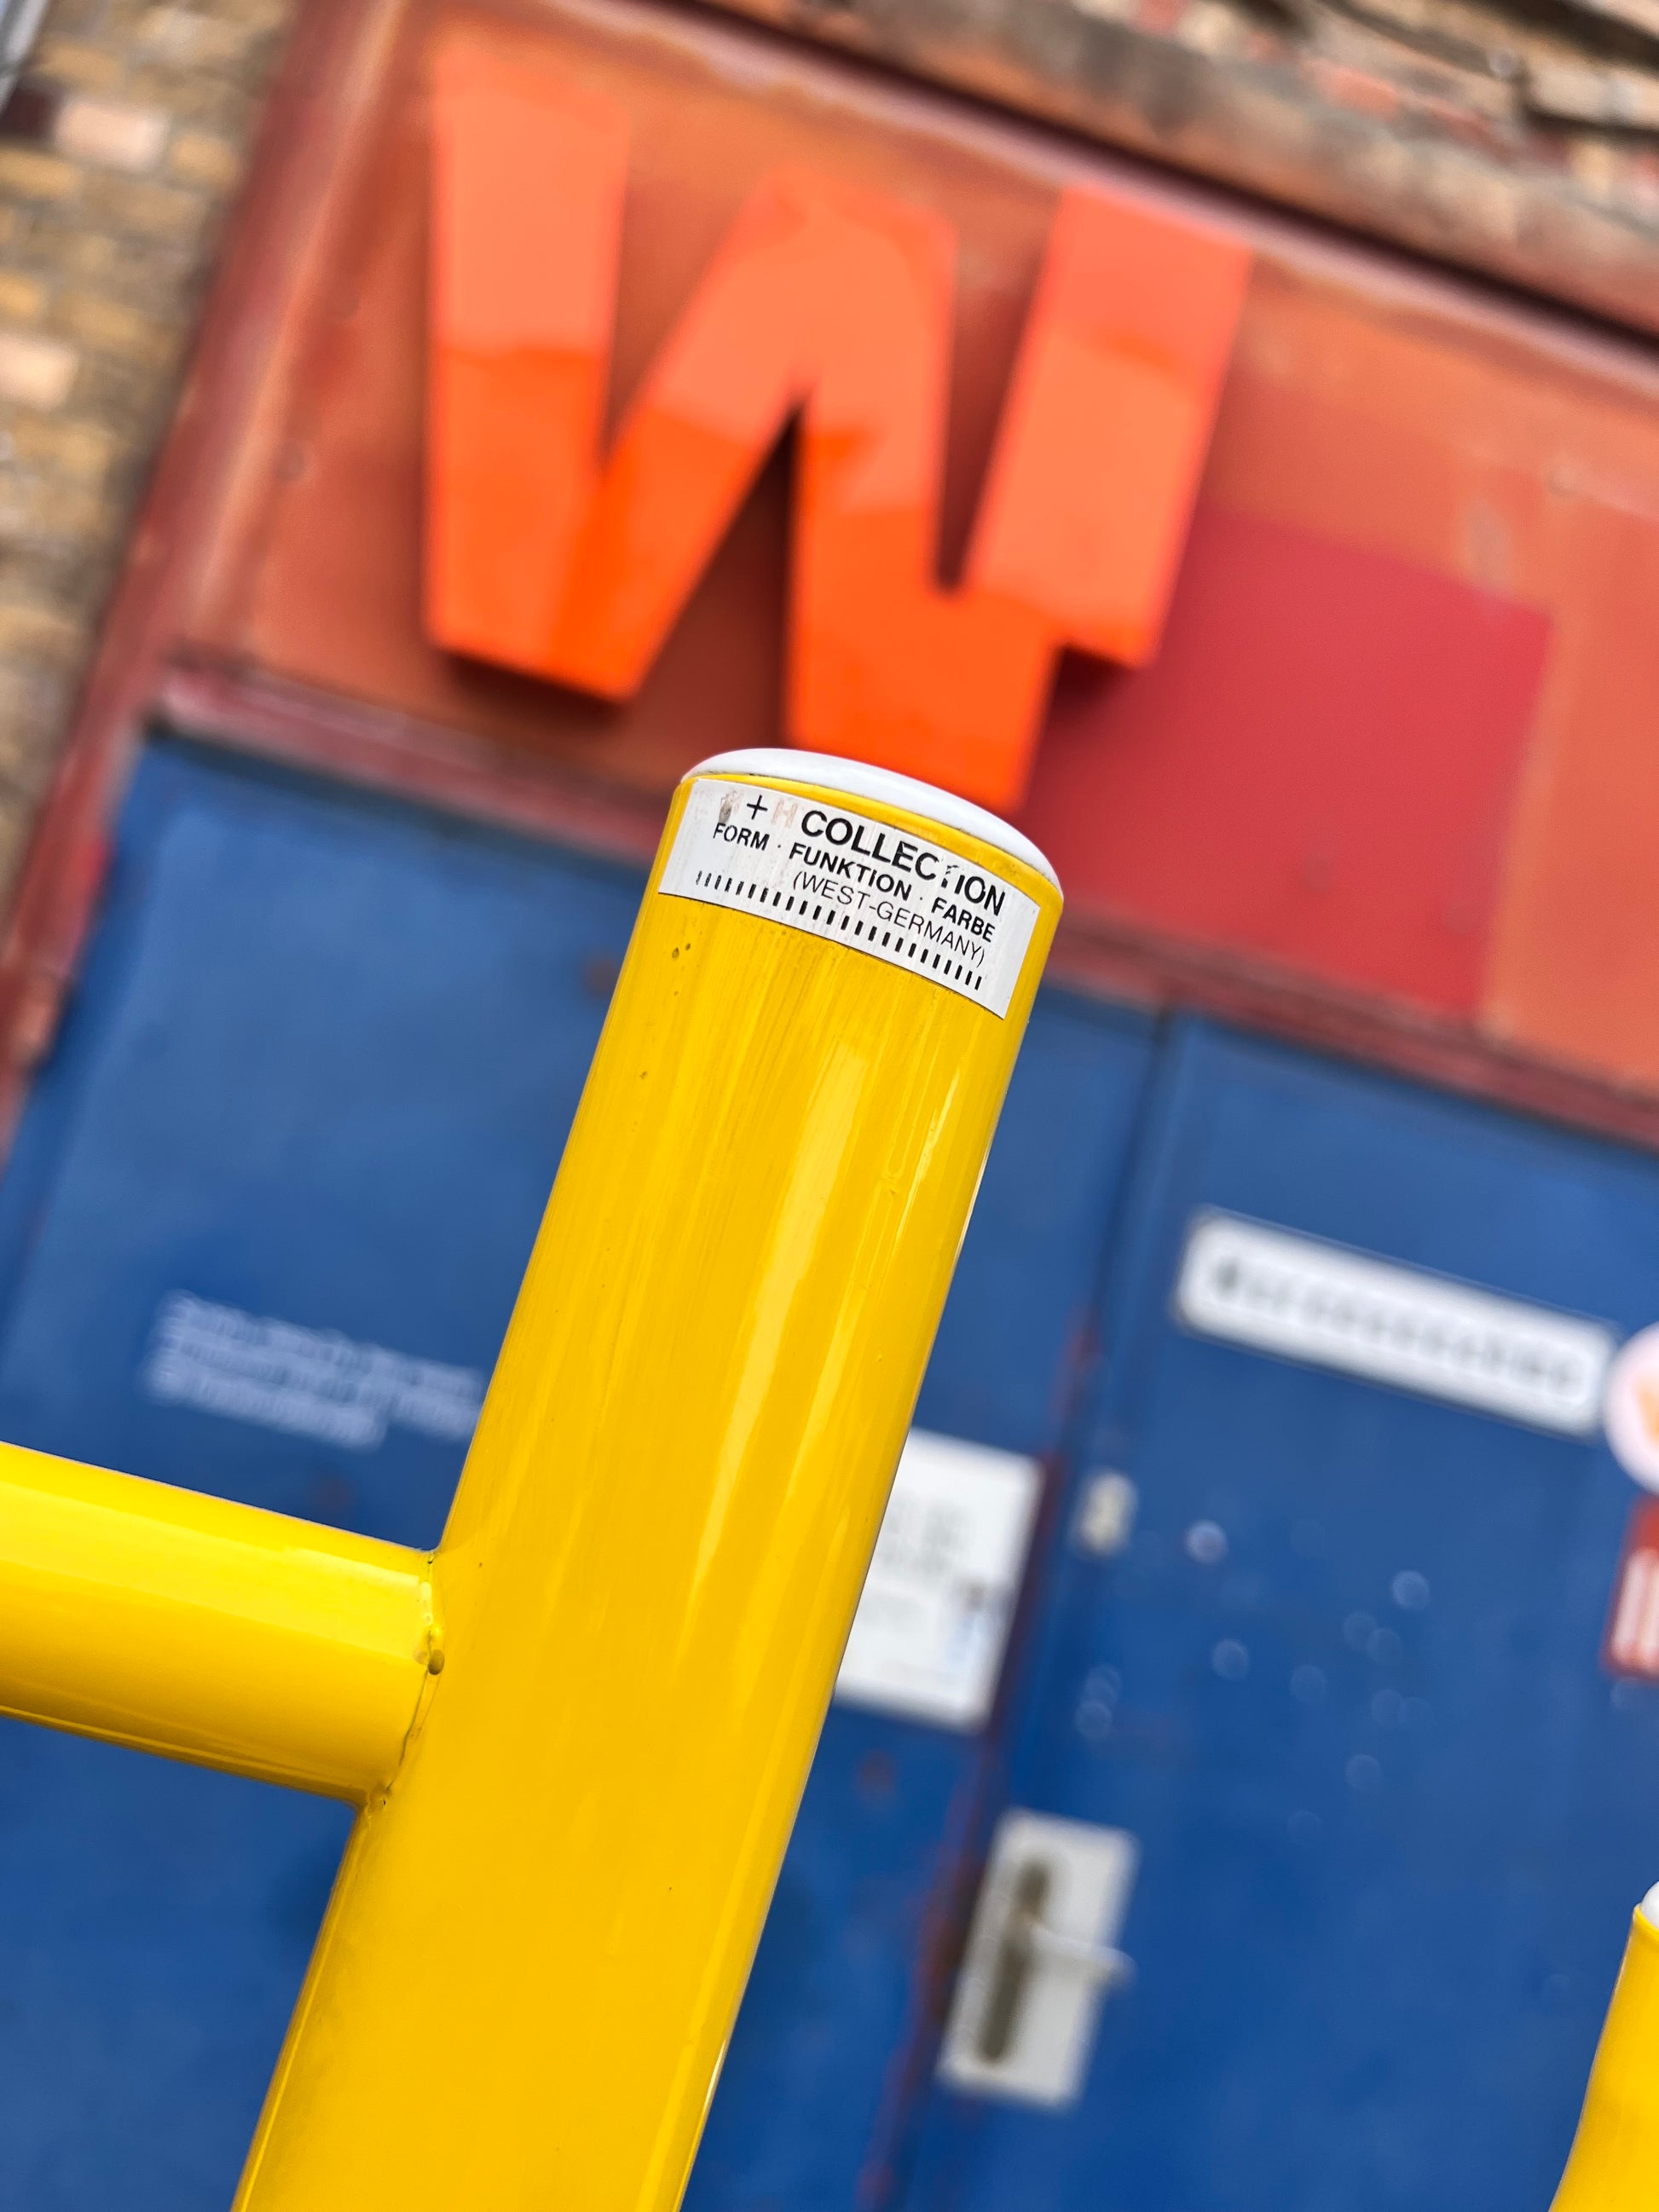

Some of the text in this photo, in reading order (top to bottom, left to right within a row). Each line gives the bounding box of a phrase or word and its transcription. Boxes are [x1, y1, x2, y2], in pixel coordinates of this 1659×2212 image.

[713, 822, 771, 852] FORM
[789, 841, 913, 901] FUNKTION
[930, 896, 996, 944] FARBE
[793, 870, 985, 968] (WEST-GERMANY)
